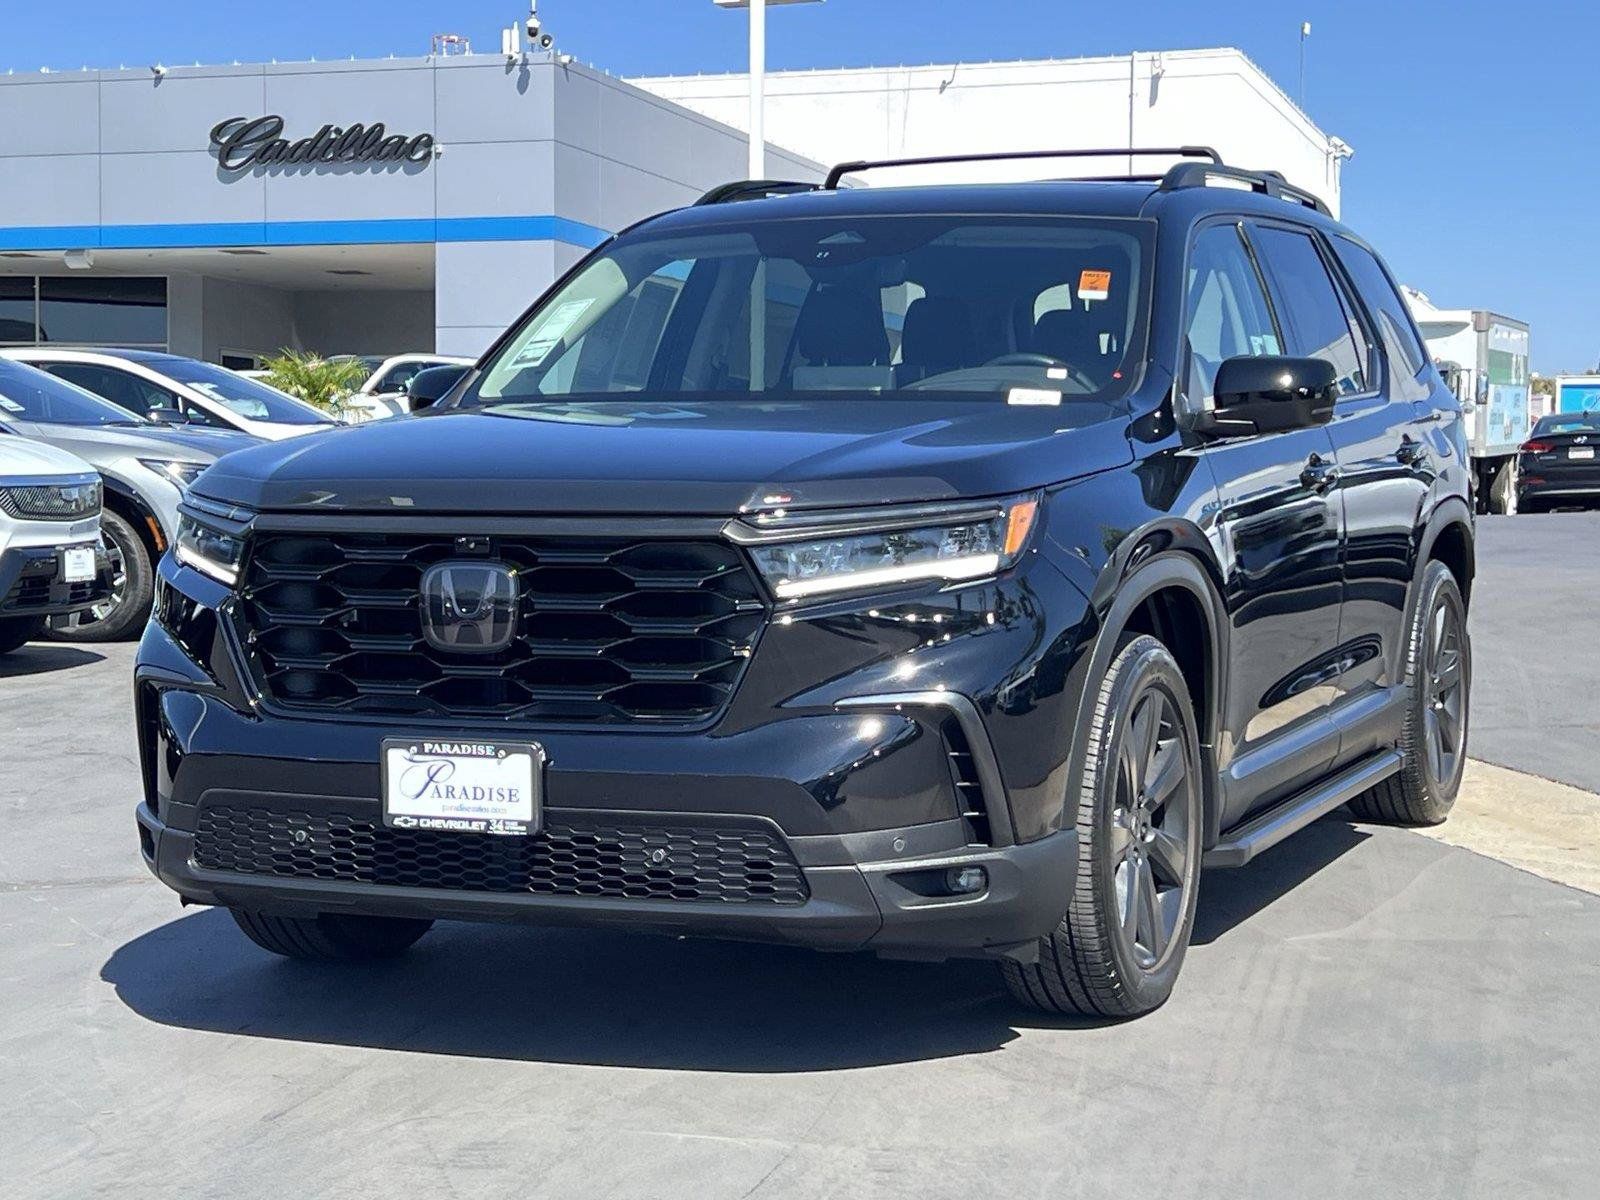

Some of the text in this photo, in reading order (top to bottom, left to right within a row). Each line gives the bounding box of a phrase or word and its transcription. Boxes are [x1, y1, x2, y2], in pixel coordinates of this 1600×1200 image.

[209, 114, 434, 171] Cadillac
[423, 743, 496, 756] PARADISE
[399, 755, 520, 803] PARADISE
[419, 818, 487, 831] CHEVROLET
